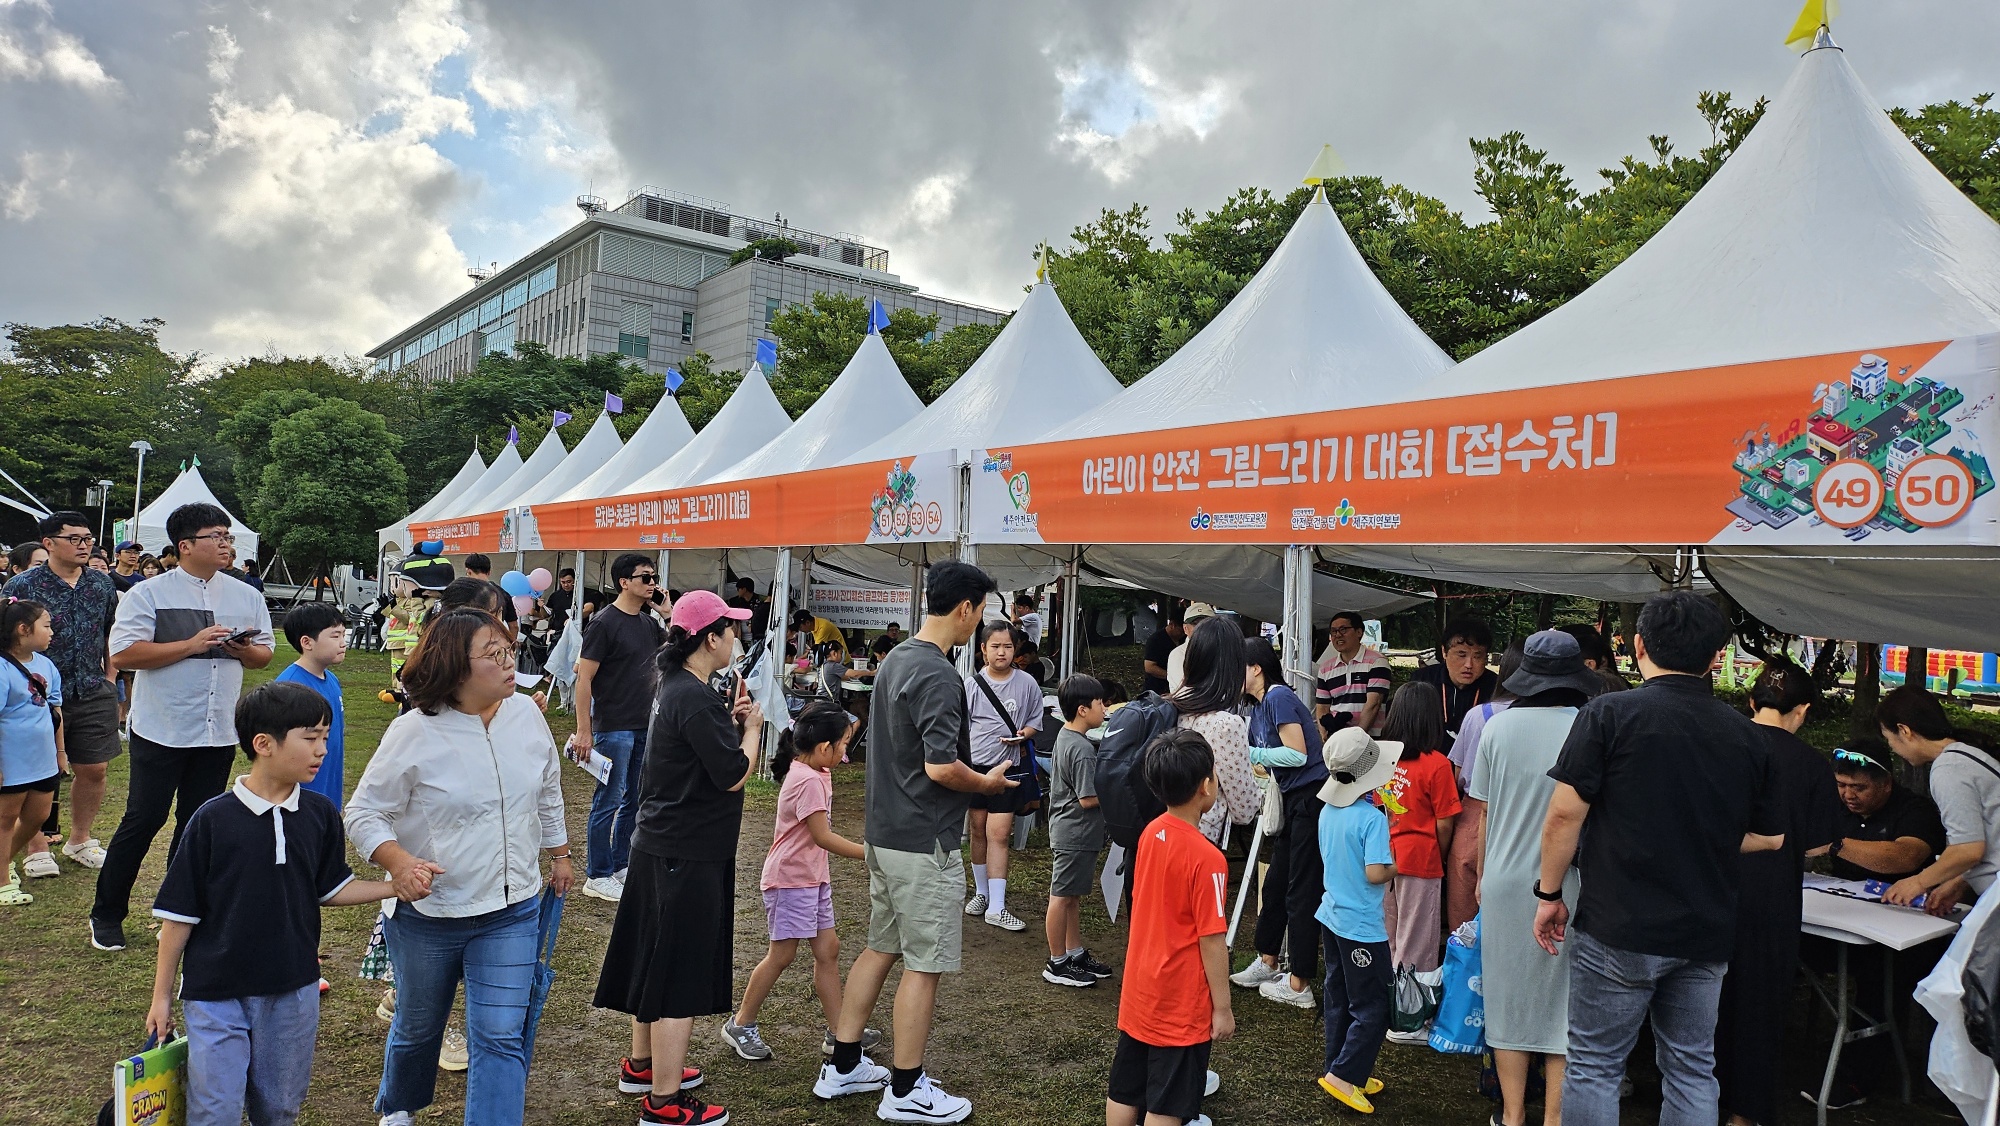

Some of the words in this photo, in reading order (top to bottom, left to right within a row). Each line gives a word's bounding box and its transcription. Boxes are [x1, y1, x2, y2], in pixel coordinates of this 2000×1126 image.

[1083, 454, 1145, 495] 어린이
[1152, 450, 1200, 492] 안전
[1207, 436, 1353, 489] 그림그리기
[1364, 428, 1434, 480] 대회
[1447, 411, 1618, 476] [접수처]
[1823, 478, 1871, 508] 49
[1907, 475, 1960, 506] 50
[638, 500, 662, 526] 어린이
[663, 498, 680, 525] 안전
[682, 493, 727, 523] 그림그리기
[729, 490, 750, 519] 대회
[882, 514, 890, 528] 51
[896, 514, 906, 526] 52
[912, 512, 922, 526] 53
[928, 511, 939, 524] 54
[1002, 514, 1038, 527] 제주안전도시
[1292, 516, 1336, 529] 안전보건공단
[1352, 515, 1400, 529] 제주지역본부
[135, 1064, 143, 1072] 50
[132, 1090, 167, 1123] CRAYON
